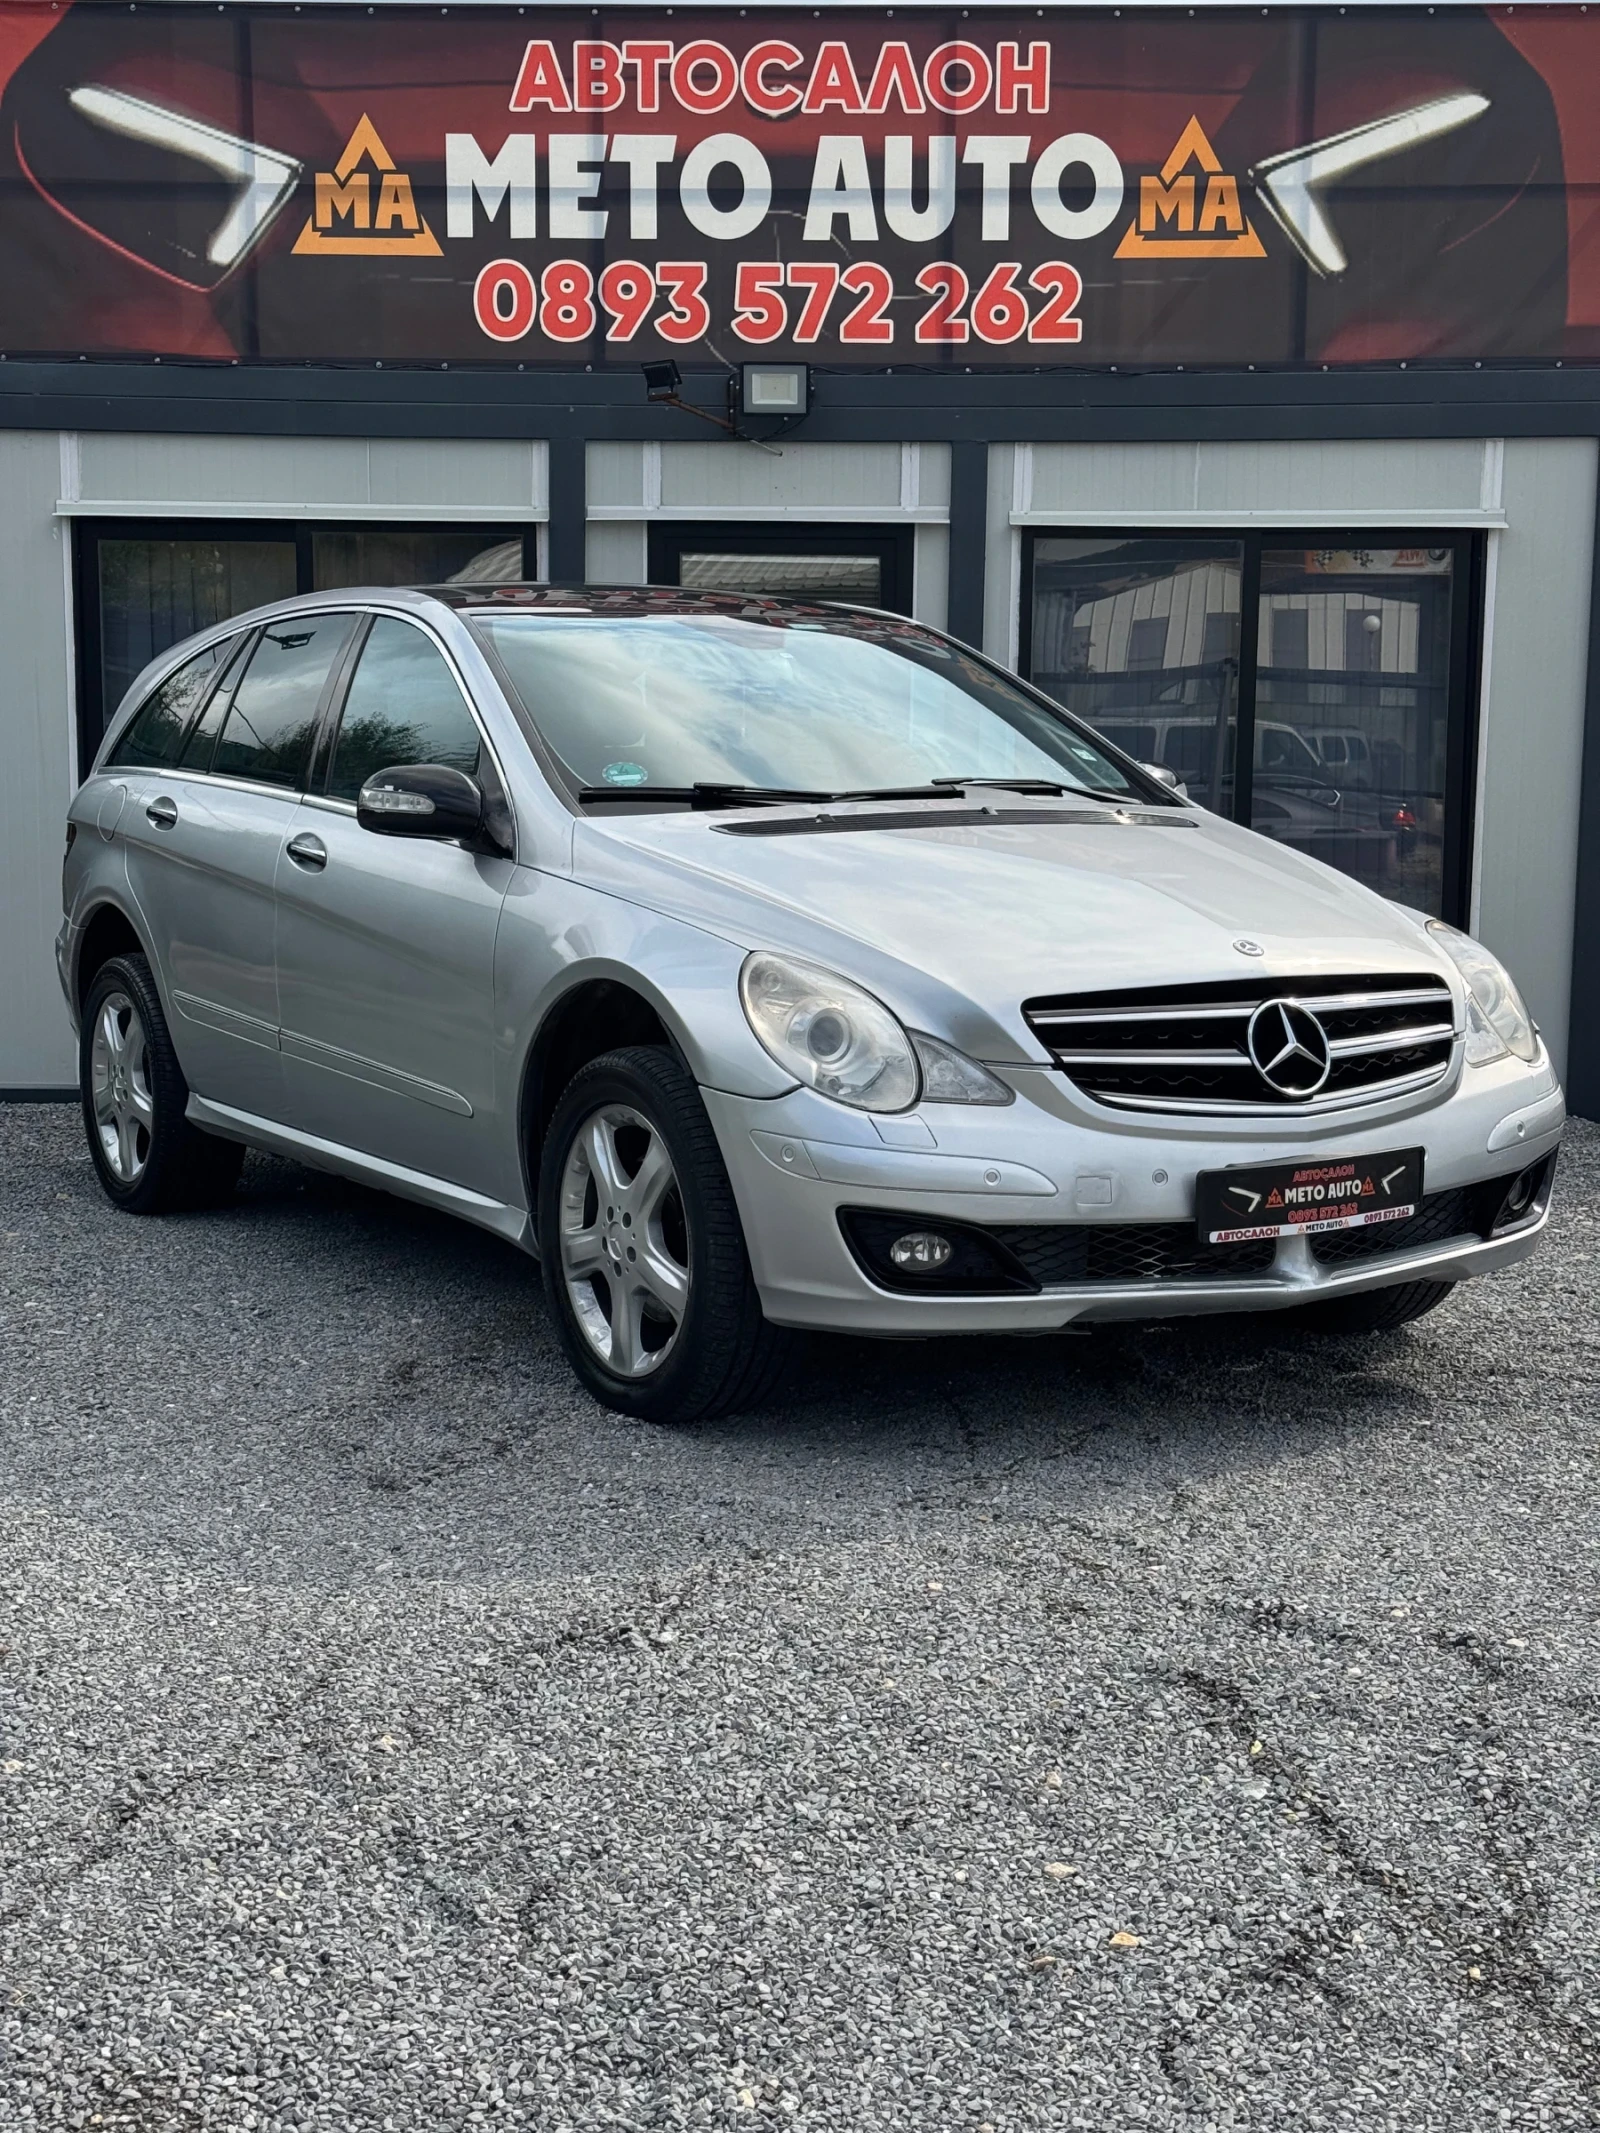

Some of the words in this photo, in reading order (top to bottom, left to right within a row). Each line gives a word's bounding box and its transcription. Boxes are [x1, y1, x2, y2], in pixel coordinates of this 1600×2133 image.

[509, 40, 1051, 115] АВТОСАЛОН
[314, 172, 420, 230] MA
[445, 132, 772, 240] METO
[803, 132, 1124, 242] AUTO
[1139, 175, 1244, 231] MA
[473, 259, 711, 343] 0893
[731, 260, 894, 344] 572
[915, 261, 1083, 344] 262
[1293, 1164, 1355, 1182] АВТОСАЛОН
[1284, 1185, 1325, 1204] METO
[1328, 1179, 1362, 1199] AUTO
[1288, 1208, 1318, 1223] 0893
[1319, 1205, 1339, 1219] 572
[1340, 1202, 1358, 1216] 262
[1364, 1212, 1382, 1223] 0893
[1383, 1210, 1396, 1220] 572
[1397, 1207, 1410, 1216] 262
[1216, 1227, 1280, 1241] АВТОСАЛОН
[1305, 1223, 1325, 1231] METO
[1326, 1219, 1343, 1229] AUTO
